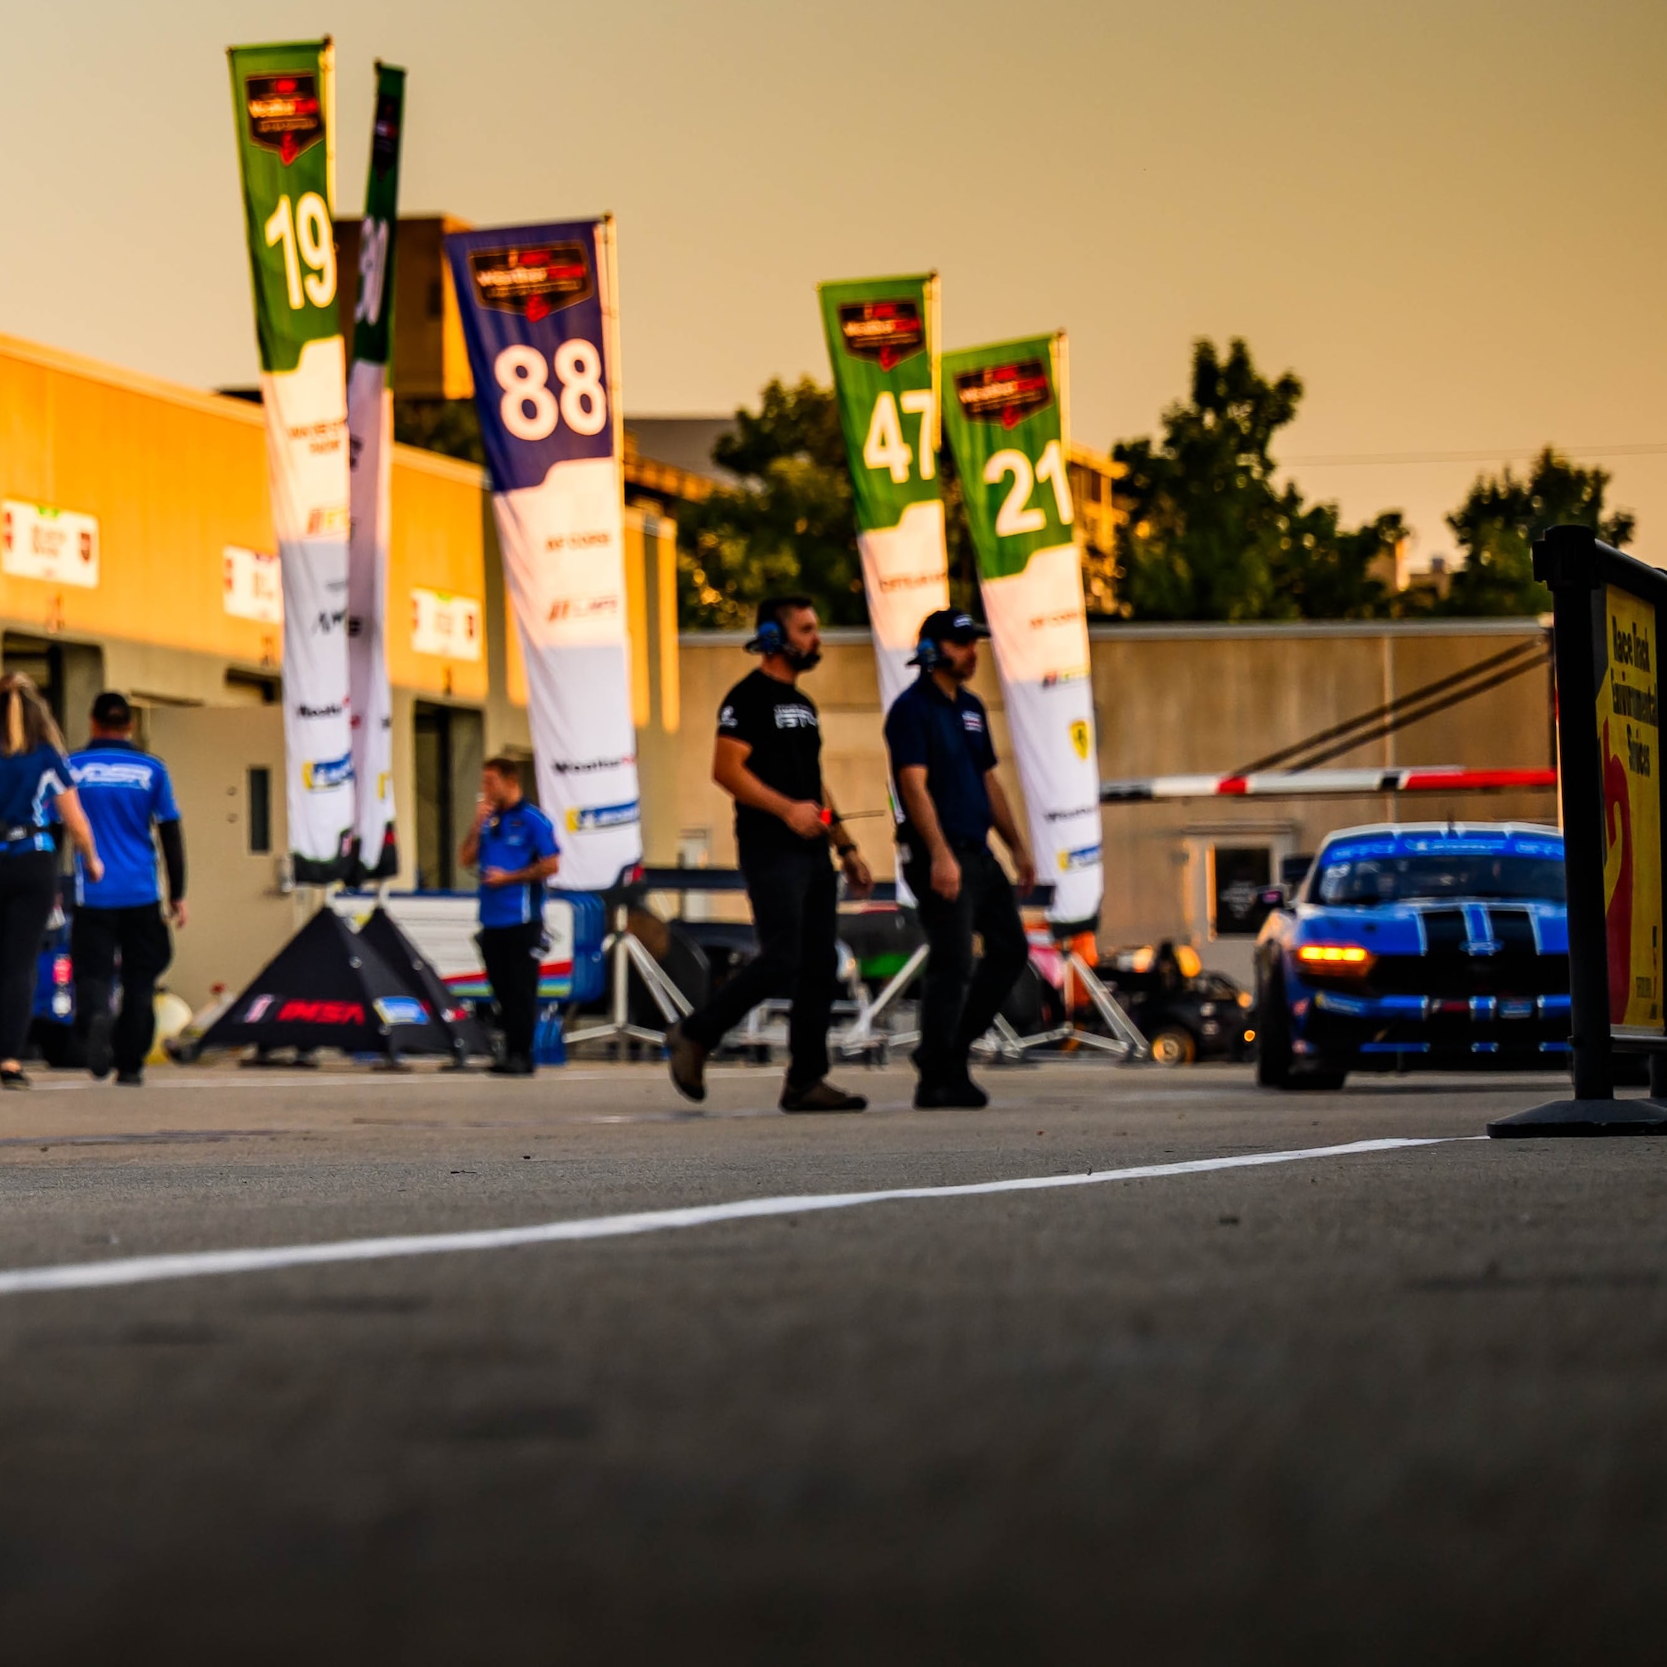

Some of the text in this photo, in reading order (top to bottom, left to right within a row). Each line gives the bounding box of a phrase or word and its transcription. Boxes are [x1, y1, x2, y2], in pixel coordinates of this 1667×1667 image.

[265, 192, 337, 310] 19
[494, 338, 607, 441] 88
[863, 390, 935, 483] 47
[983, 439, 1074, 538] 21
